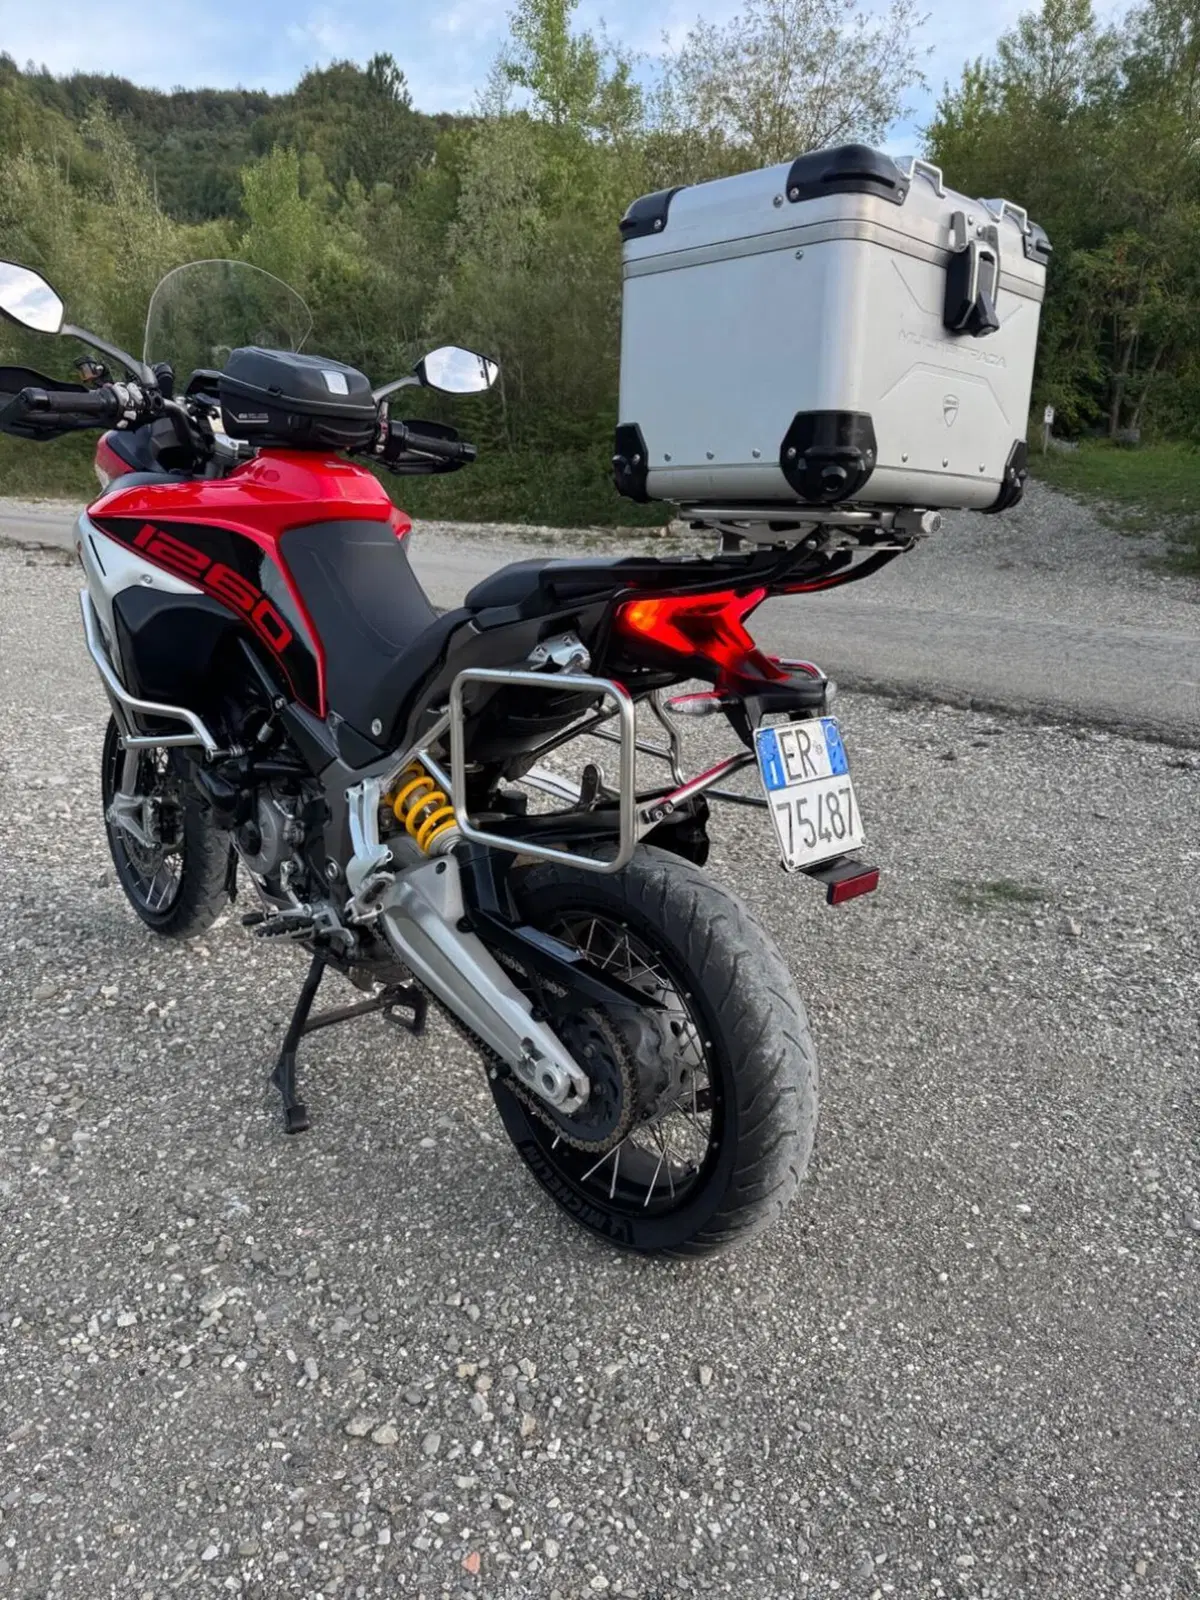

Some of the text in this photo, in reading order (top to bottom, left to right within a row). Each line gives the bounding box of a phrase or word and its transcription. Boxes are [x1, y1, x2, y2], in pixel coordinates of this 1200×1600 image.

[132, 523, 293, 653] 1260
[778, 728, 818, 783] ER
[775, 787, 854, 855] 75487
[522, 1145, 607, 1229] MICHELIN
